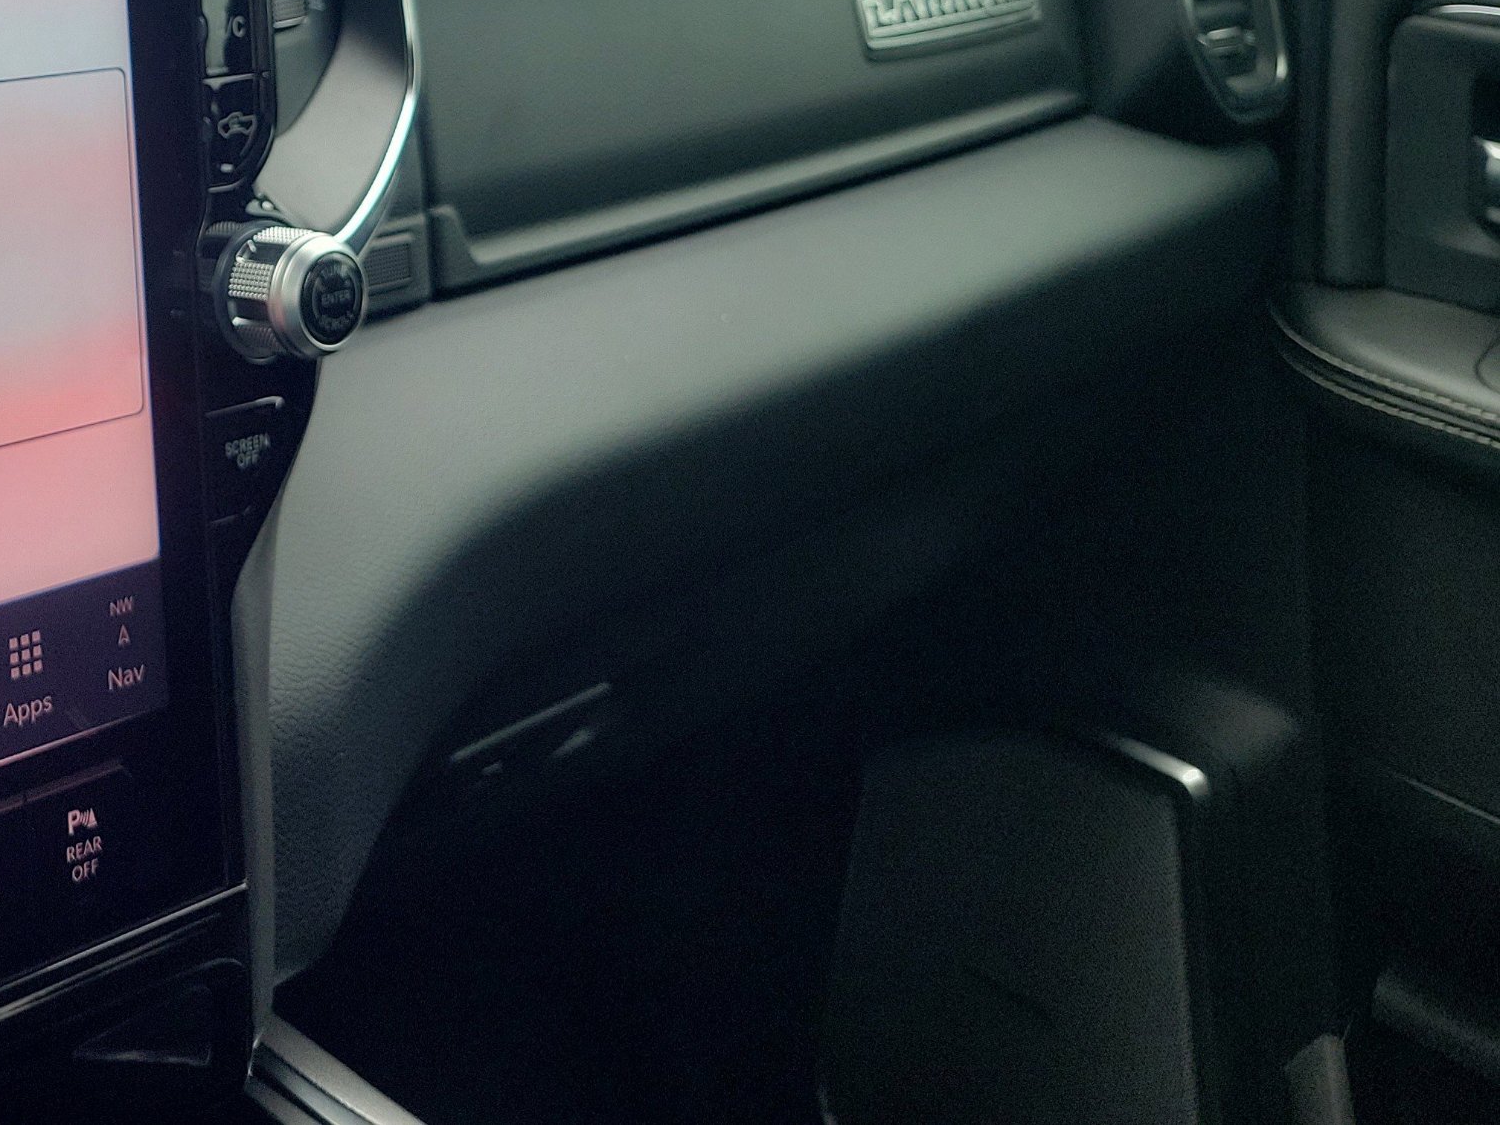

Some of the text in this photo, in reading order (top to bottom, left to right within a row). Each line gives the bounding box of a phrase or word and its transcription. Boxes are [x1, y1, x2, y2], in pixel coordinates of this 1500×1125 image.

[225, 432, 272, 460] SCREEN
[237, 449, 260, 469] OFF
[109, 595, 134, 617] NW
[107, 663, 146, 692] Nav
[3, 694, 54, 729] Apps
[66, 835, 103, 863] REAR
[71, 858, 100, 883] OFF
